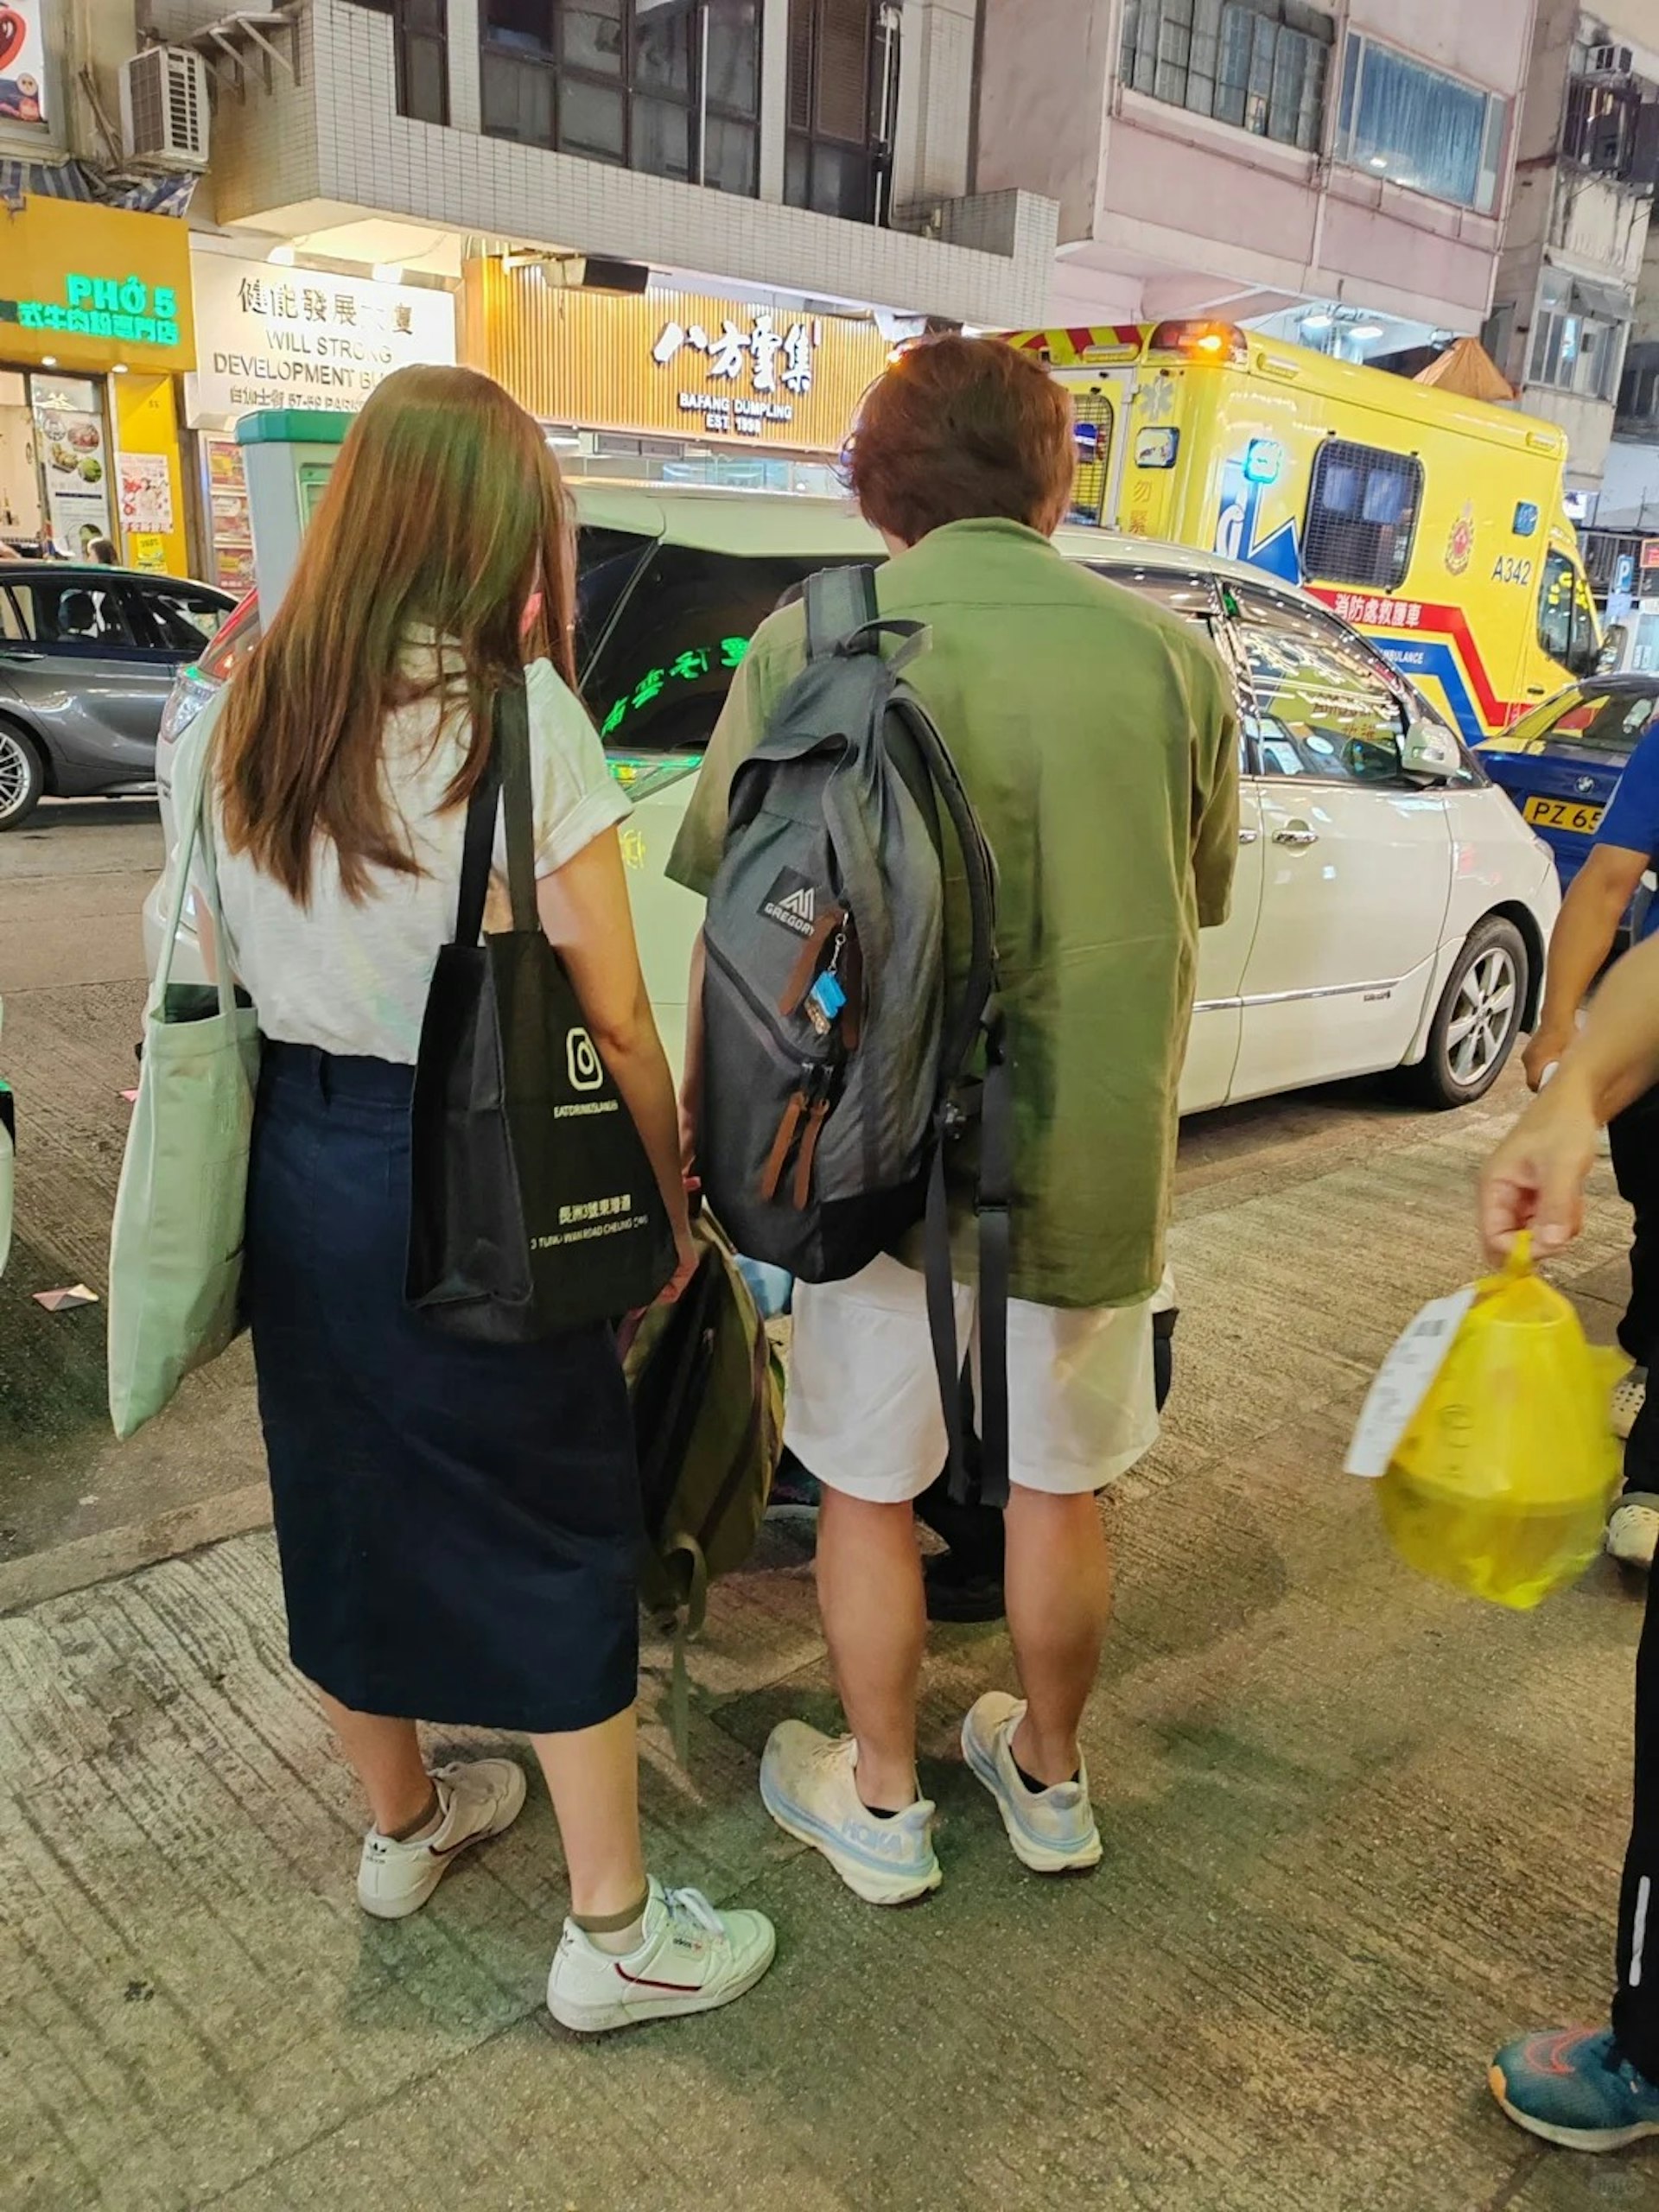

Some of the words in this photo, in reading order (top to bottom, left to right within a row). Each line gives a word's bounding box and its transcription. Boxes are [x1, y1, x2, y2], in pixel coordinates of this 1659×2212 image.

[154, 287, 176, 319] 5
[266, 329, 311, 353] WILL
[213, 353, 356, 387] DEVELOPMENT
[677, 392, 730, 414] BAFANG
[734, 399, 793, 422] DUMPLING
[1491, 555, 1531, 586] A342
[1619, 562, 1631, 590] P
[1334, 593, 1422, 628] 消防處救護車
[1533, 802, 1567, 824] PZ
[1573, 810, 1602, 830] 65
[764, 902, 815, 937] GREGORY
